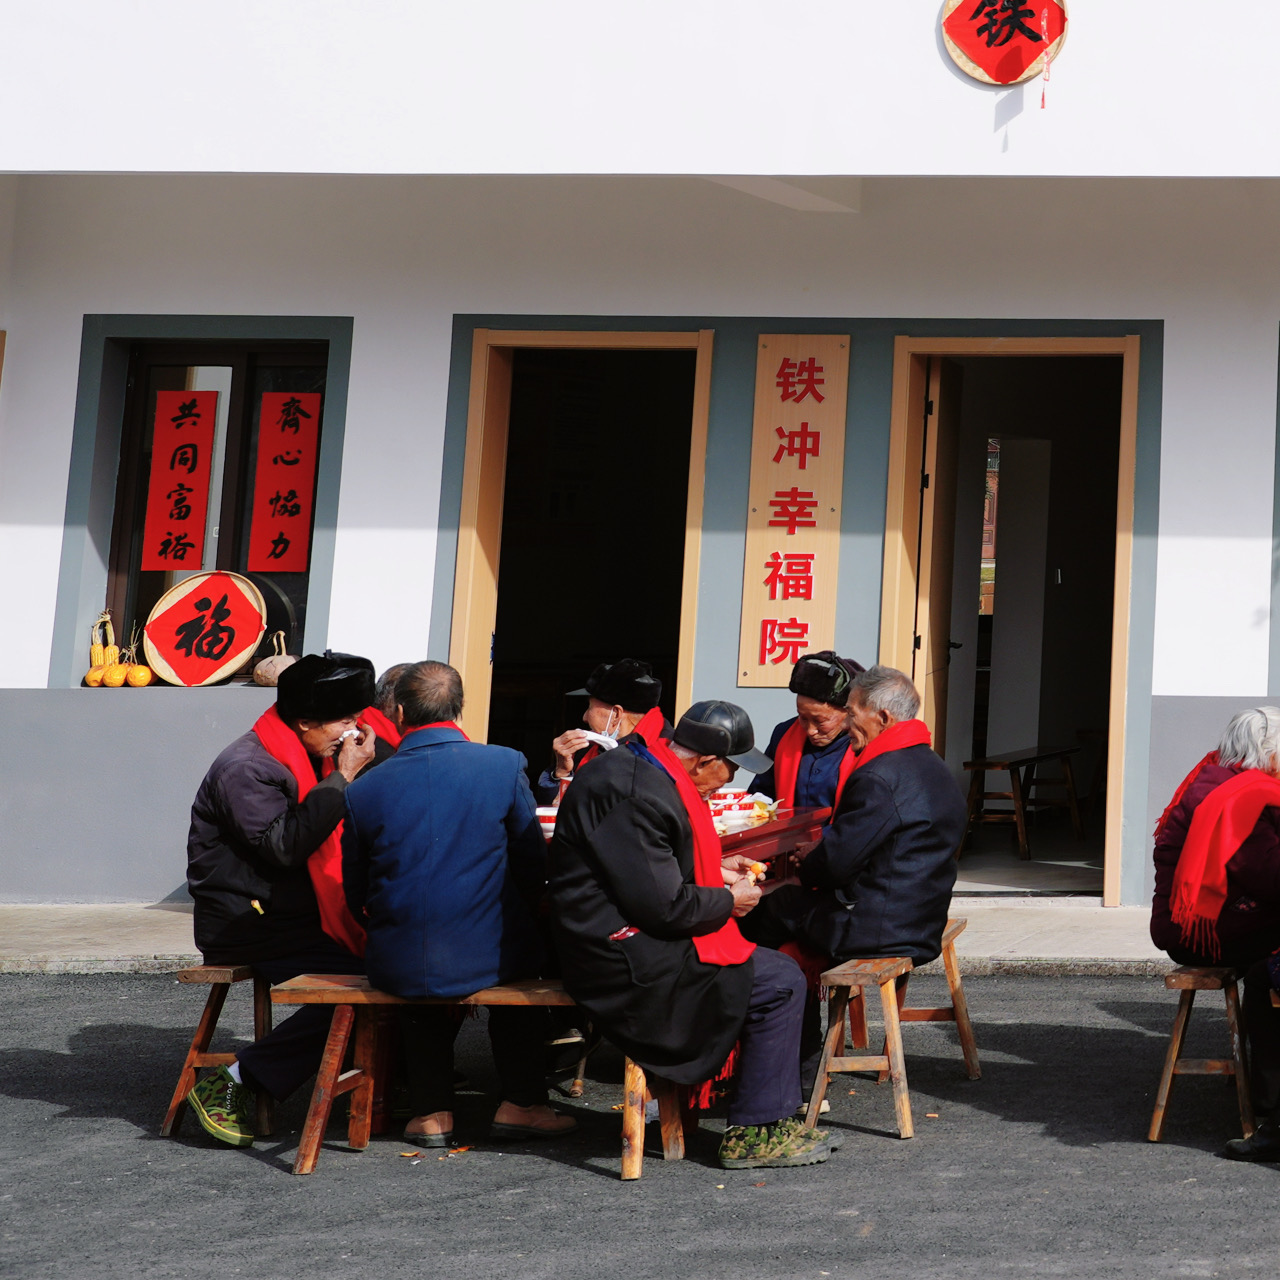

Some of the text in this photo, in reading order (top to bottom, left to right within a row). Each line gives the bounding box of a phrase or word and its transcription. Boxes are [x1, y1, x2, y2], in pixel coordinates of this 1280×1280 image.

[158, 398, 201, 561] 共同富裕
[759, 357, 825, 665] 铁冲幸福院
[174, 593, 236, 661] 福
